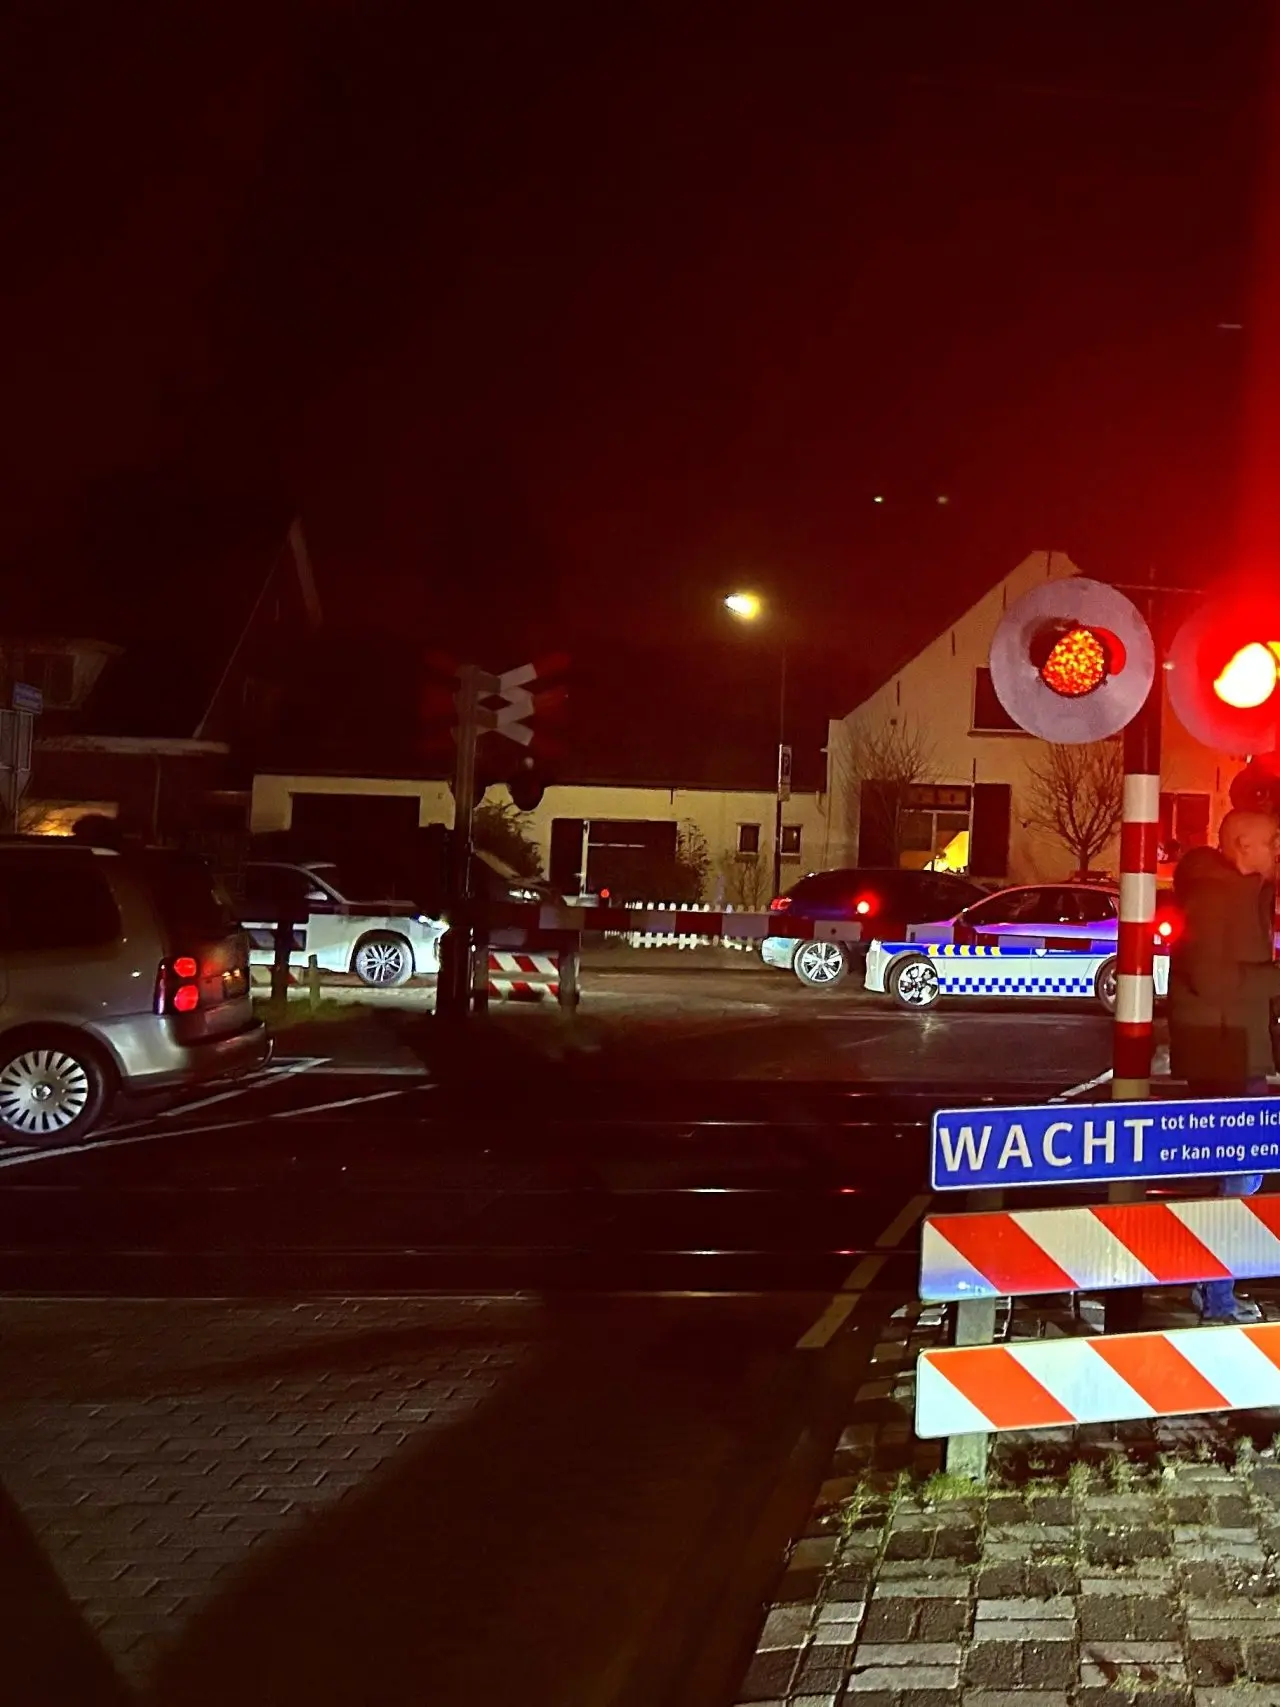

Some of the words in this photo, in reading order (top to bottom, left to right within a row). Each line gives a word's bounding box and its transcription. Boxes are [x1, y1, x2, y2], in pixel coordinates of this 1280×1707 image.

[1161, 1114, 1185, 1130] tot
[1189, 1112, 1216, 1129] het
[1220, 1111, 1256, 1128] rode
[939, 1118, 1154, 1172] WACHT
[1160, 1147, 1178, 1161] er
[1181, 1143, 1211, 1160] kan
[1215, 1144, 1245, 1162] nog
[1250, 1143, 1279, 1157] een
